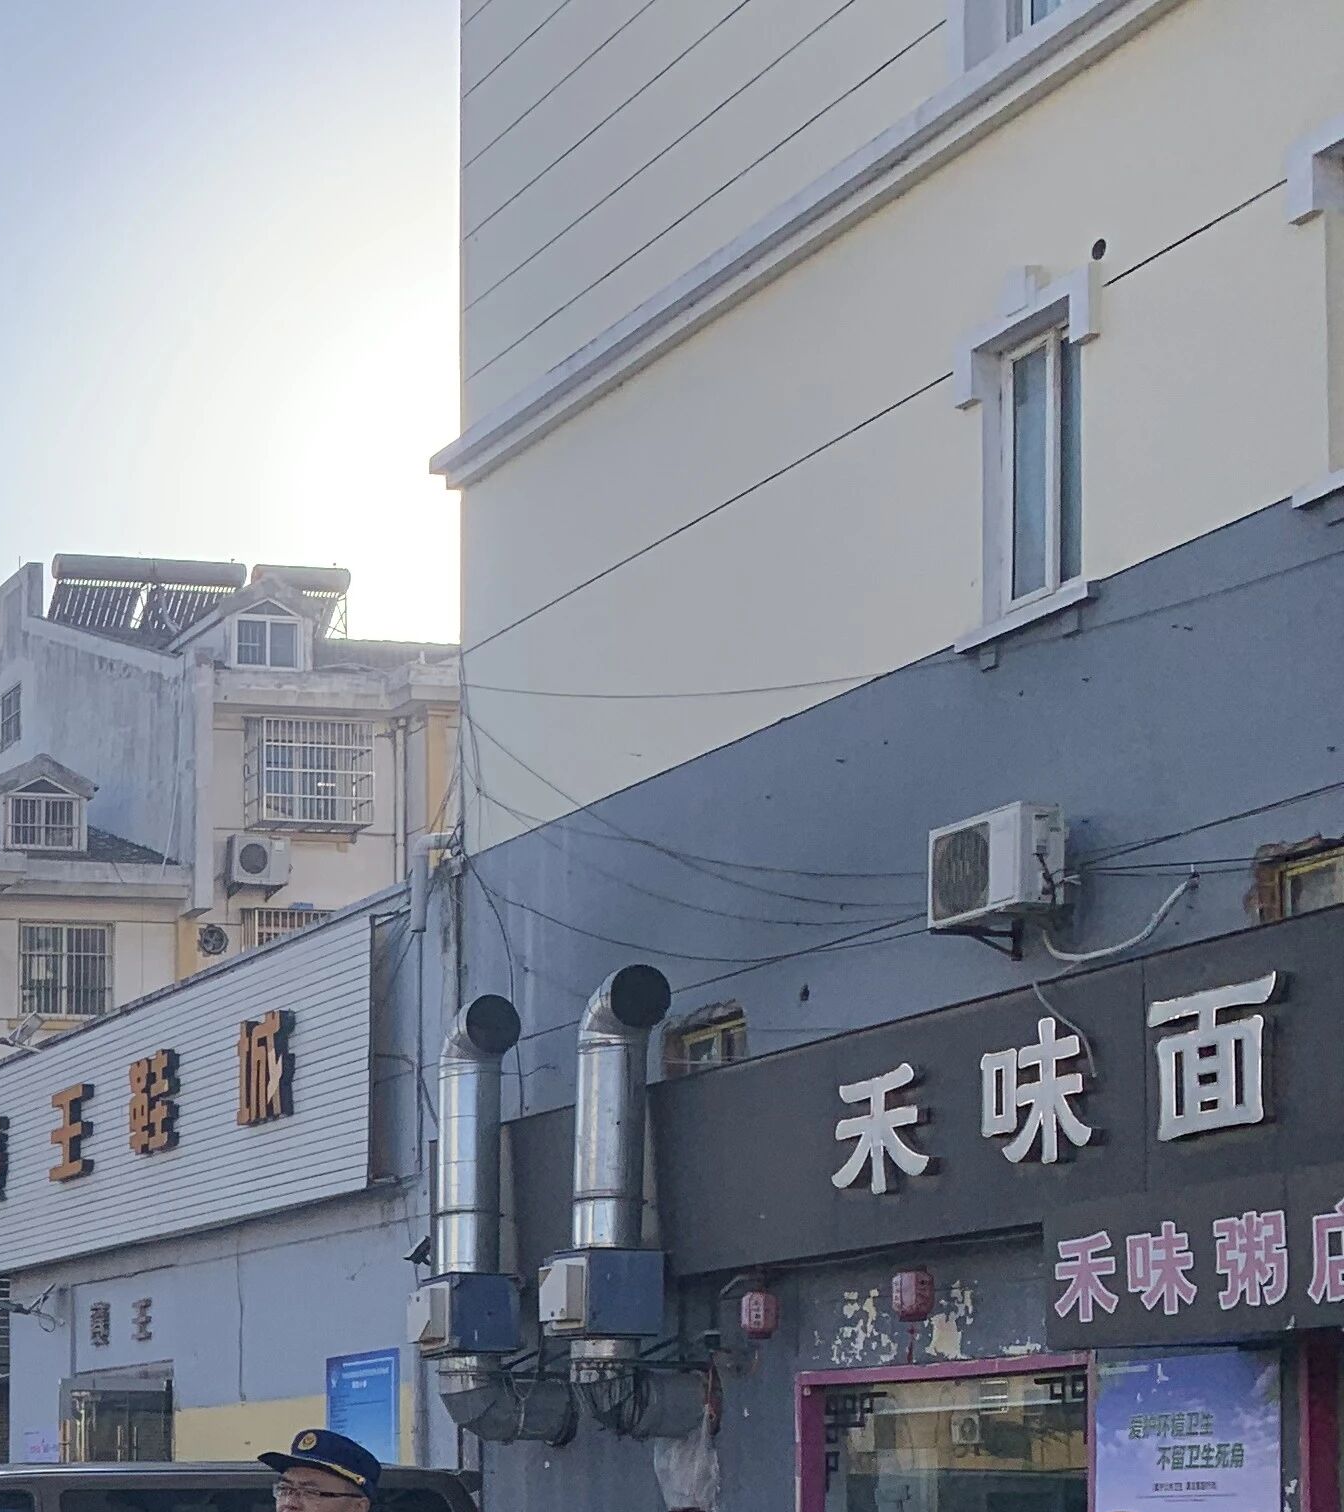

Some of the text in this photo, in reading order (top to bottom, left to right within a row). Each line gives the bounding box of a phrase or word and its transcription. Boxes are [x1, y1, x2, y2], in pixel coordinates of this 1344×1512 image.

[830, 971, 1277, 1195] 禾味面
[1128, 1411, 1215, 1440] 爱护环境卫生
[1156, 1442, 1245, 1471] 不留卫生死角
